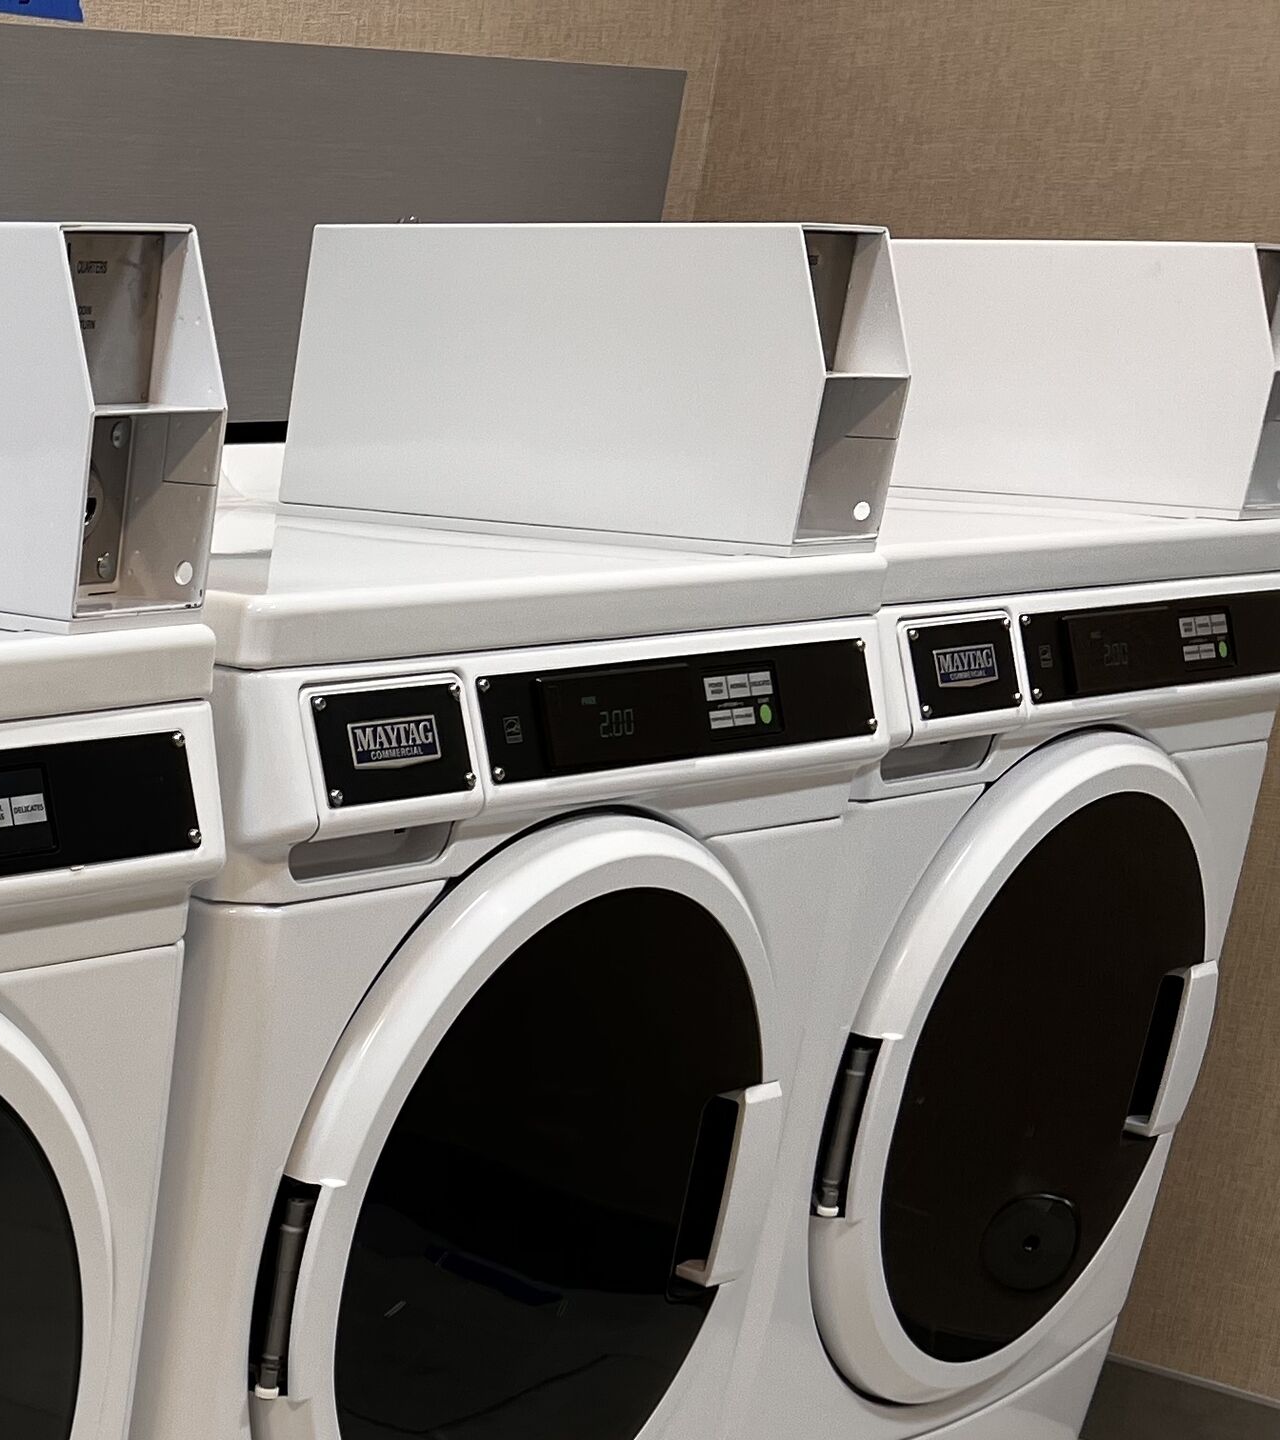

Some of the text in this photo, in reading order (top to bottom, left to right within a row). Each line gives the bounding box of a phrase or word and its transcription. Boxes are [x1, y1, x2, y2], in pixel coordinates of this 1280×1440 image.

[937, 649, 993, 673] MAYTAG
[599, 708, 635, 738] 2.00
[352, 721, 434, 752] MAYTAG
[370, 746, 424, 761] COMMERCIAL
[13, 803, 44, 815] DELICATES
